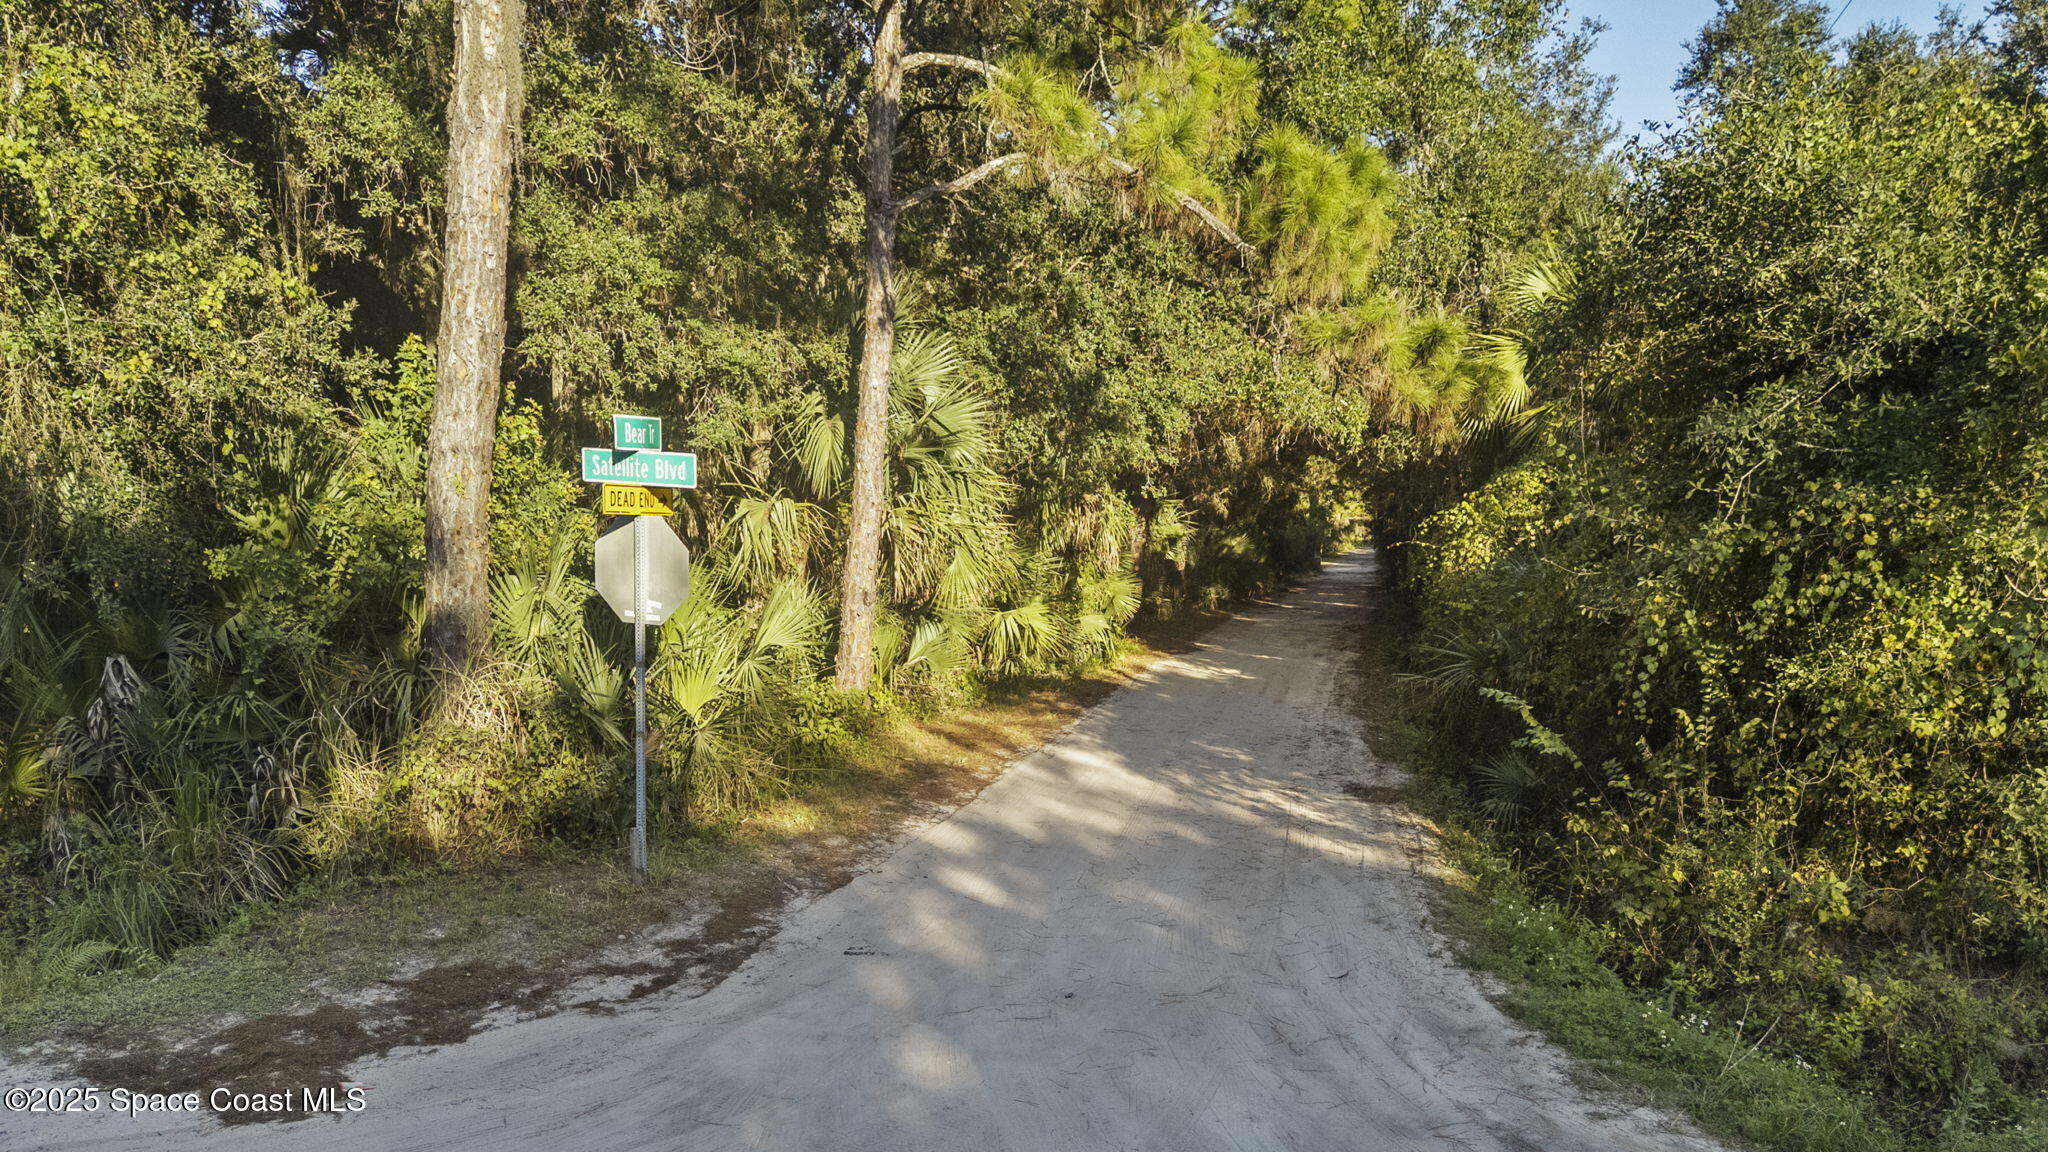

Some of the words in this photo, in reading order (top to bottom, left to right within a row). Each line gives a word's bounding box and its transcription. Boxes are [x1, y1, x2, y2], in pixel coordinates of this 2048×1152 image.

[624, 422, 646, 444] Bear
[648, 424, 655, 444] Tr
[592, 455, 648, 478] Satellite
[655, 458, 686, 480] Blvd
[610, 490, 635, 506] DEAD
[639, 491, 655, 508] END
